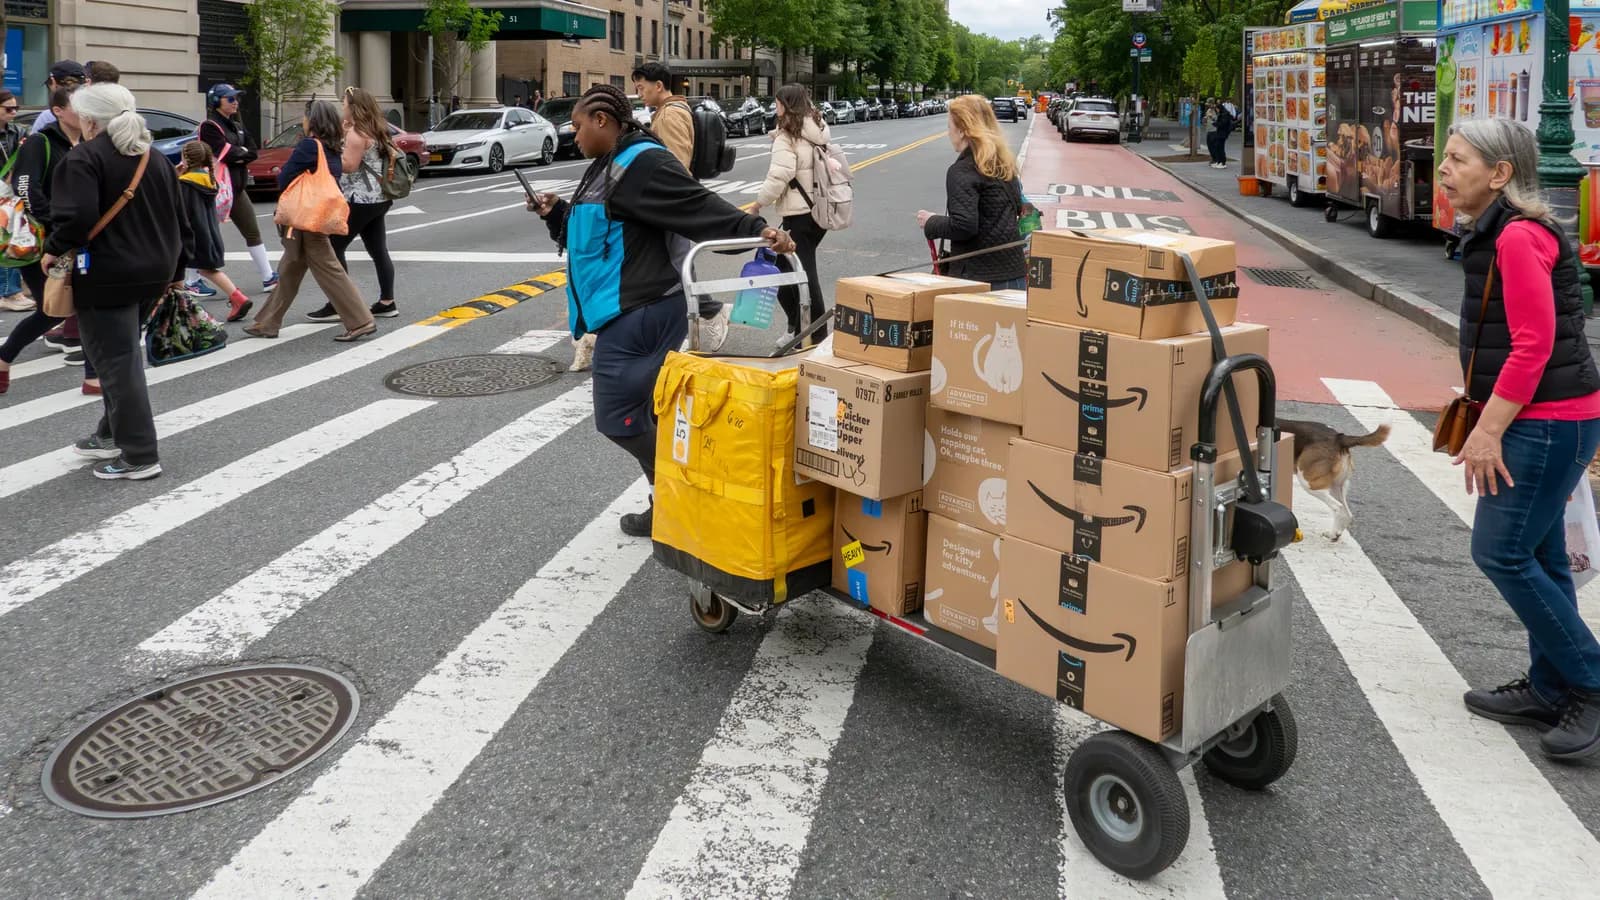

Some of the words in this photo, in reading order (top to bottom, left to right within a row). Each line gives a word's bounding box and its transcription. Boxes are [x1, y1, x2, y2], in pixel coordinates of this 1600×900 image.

[1403, 92, 1436, 104] THE
[1056, 209, 1192, 235] BUS
[1131, 277, 1139, 303] prime
[950, 320, 957, 329] If
[958, 321, 965, 329] it
[966, 322, 979, 332] fits
[954, 332, 970, 342] sits.
[800, 364, 805, 377] 8
[856, 388, 876, 403] 07977
[885, 384, 892, 402] 8
[949, 389, 985, 403] ADVANCED
[1082, 403, 1105, 414] prime
[844, 411, 871, 426] uicker
[837, 430, 863, 446] Upper
[941, 424, 962, 438] Holds
[963, 433, 978, 442] one
[940, 438, 971, 453] napping
[972, 446, 987, 456] cat.
[940, 446, 953, 458] Ok,
[955, 451, 980, 465] maybe
[981, 459, 1005, 472] three.
[941, 494, 973, 510] ADVANCED
[843, 546, 862, 561] HEAVY
[943, 538, 981, 559] Designed
[942, 548, 954, 559] for
[955, 551, 975, 569] kitty
[942, 561, 989, 584] adventures.
[1060, 601, 1083, 614] prime
[942, 608, 976, 627] ADVANCED
